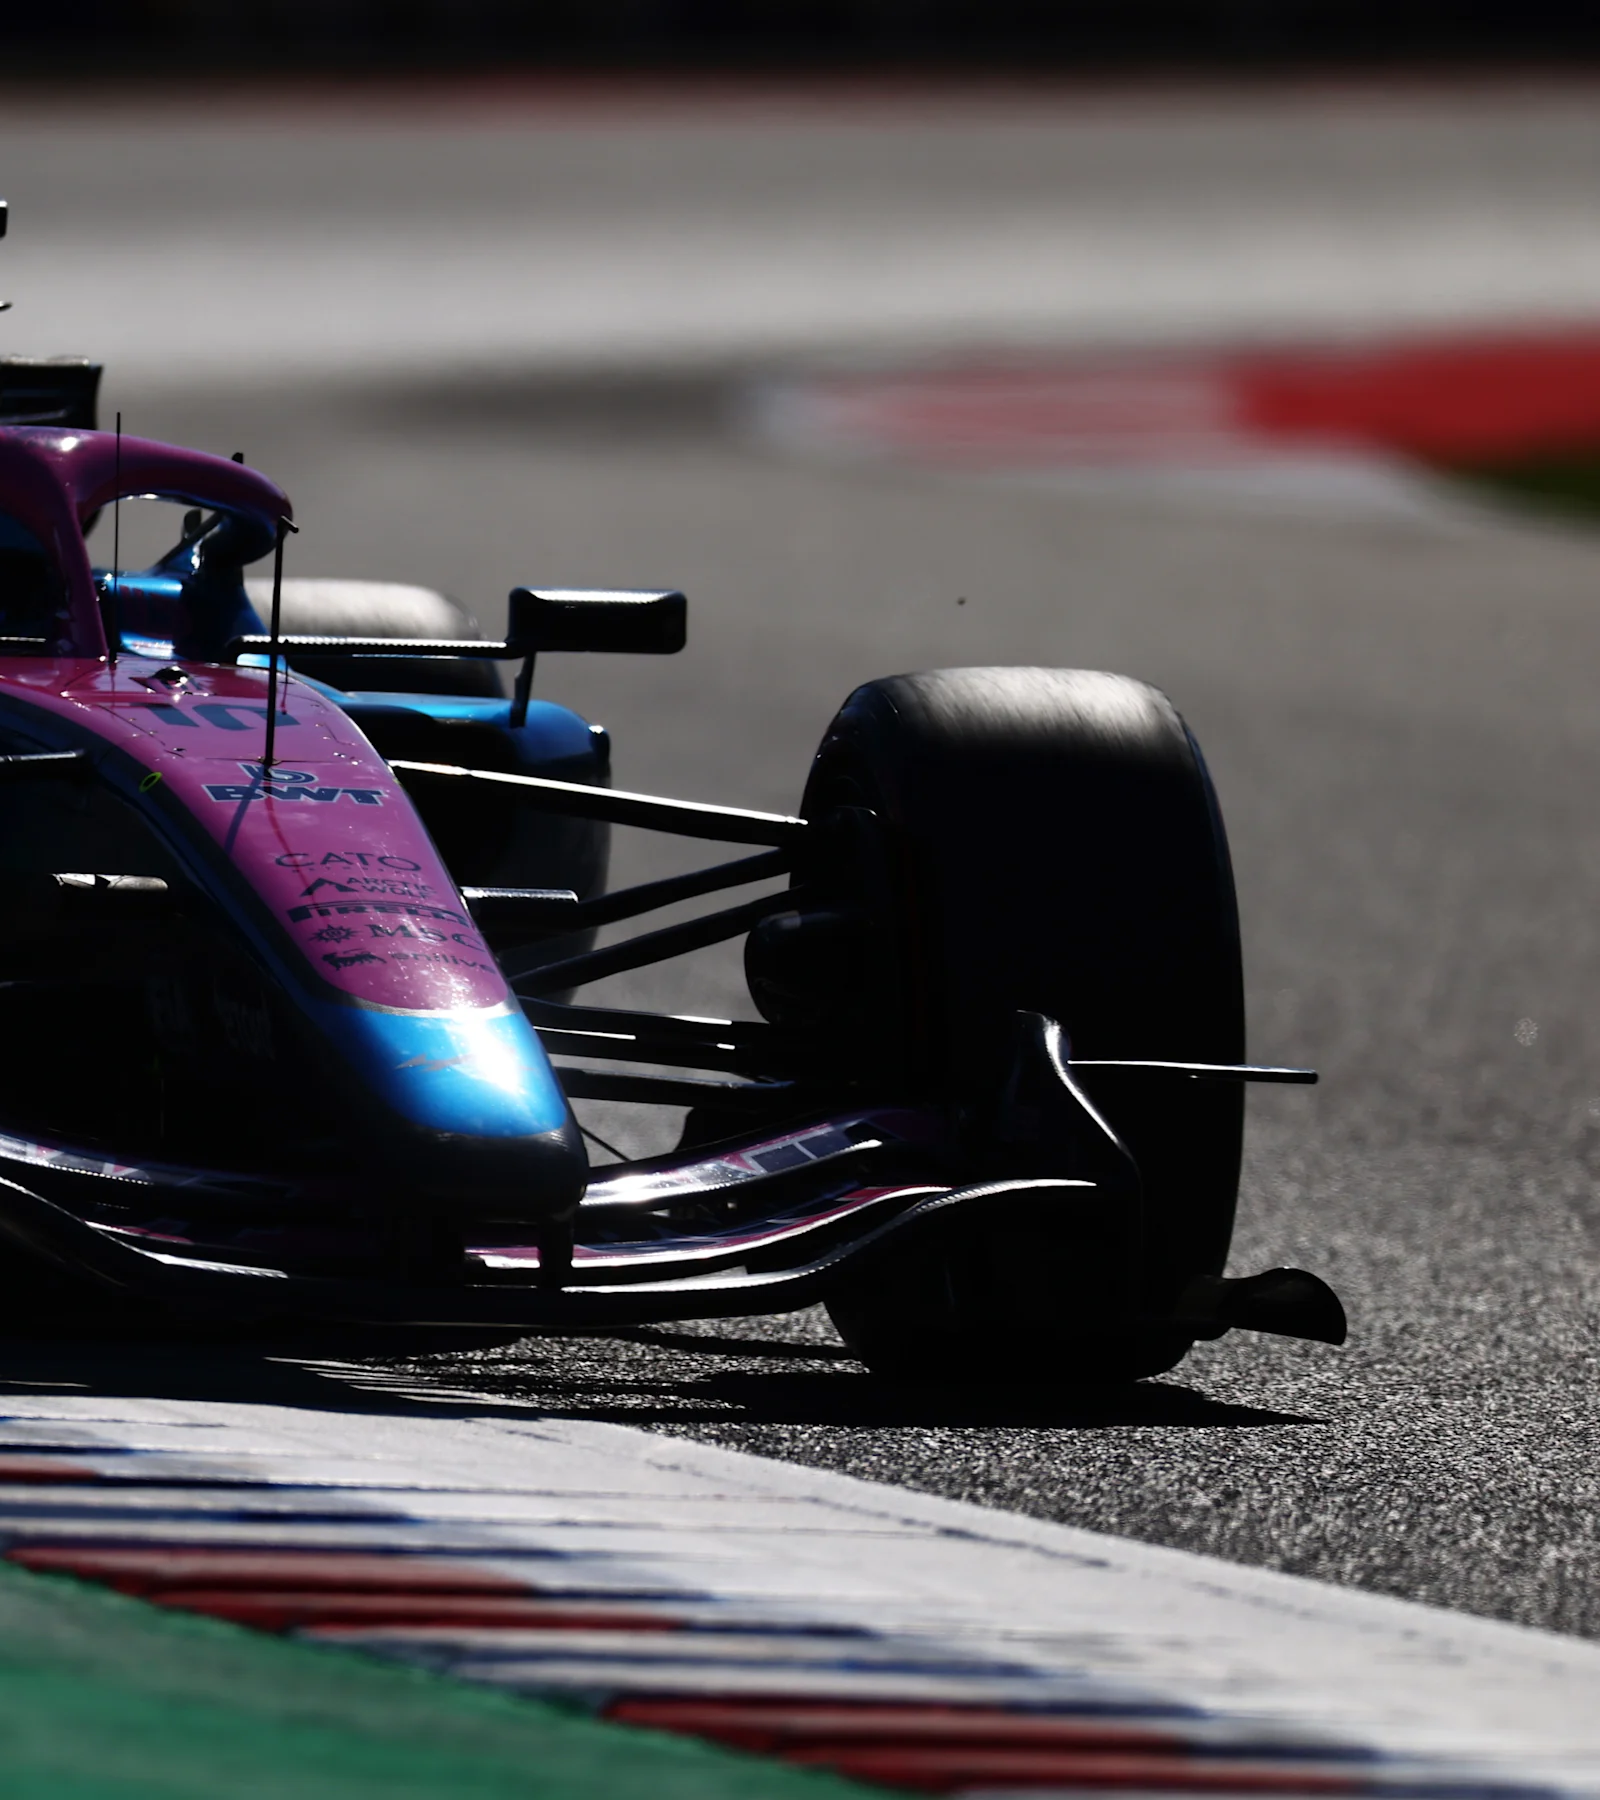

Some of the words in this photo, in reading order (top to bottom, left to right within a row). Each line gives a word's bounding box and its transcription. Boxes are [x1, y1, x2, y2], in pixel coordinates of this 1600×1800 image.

[146, 704, 301, 731] 10
[202, 784, 384, 806] BWT
[275, 852, 421, 871] CATO
[347, 877, 436, 892] ARCTIC
[362, 885, 430, 899] WOLF
[365, 924, 487, 952] MSC
